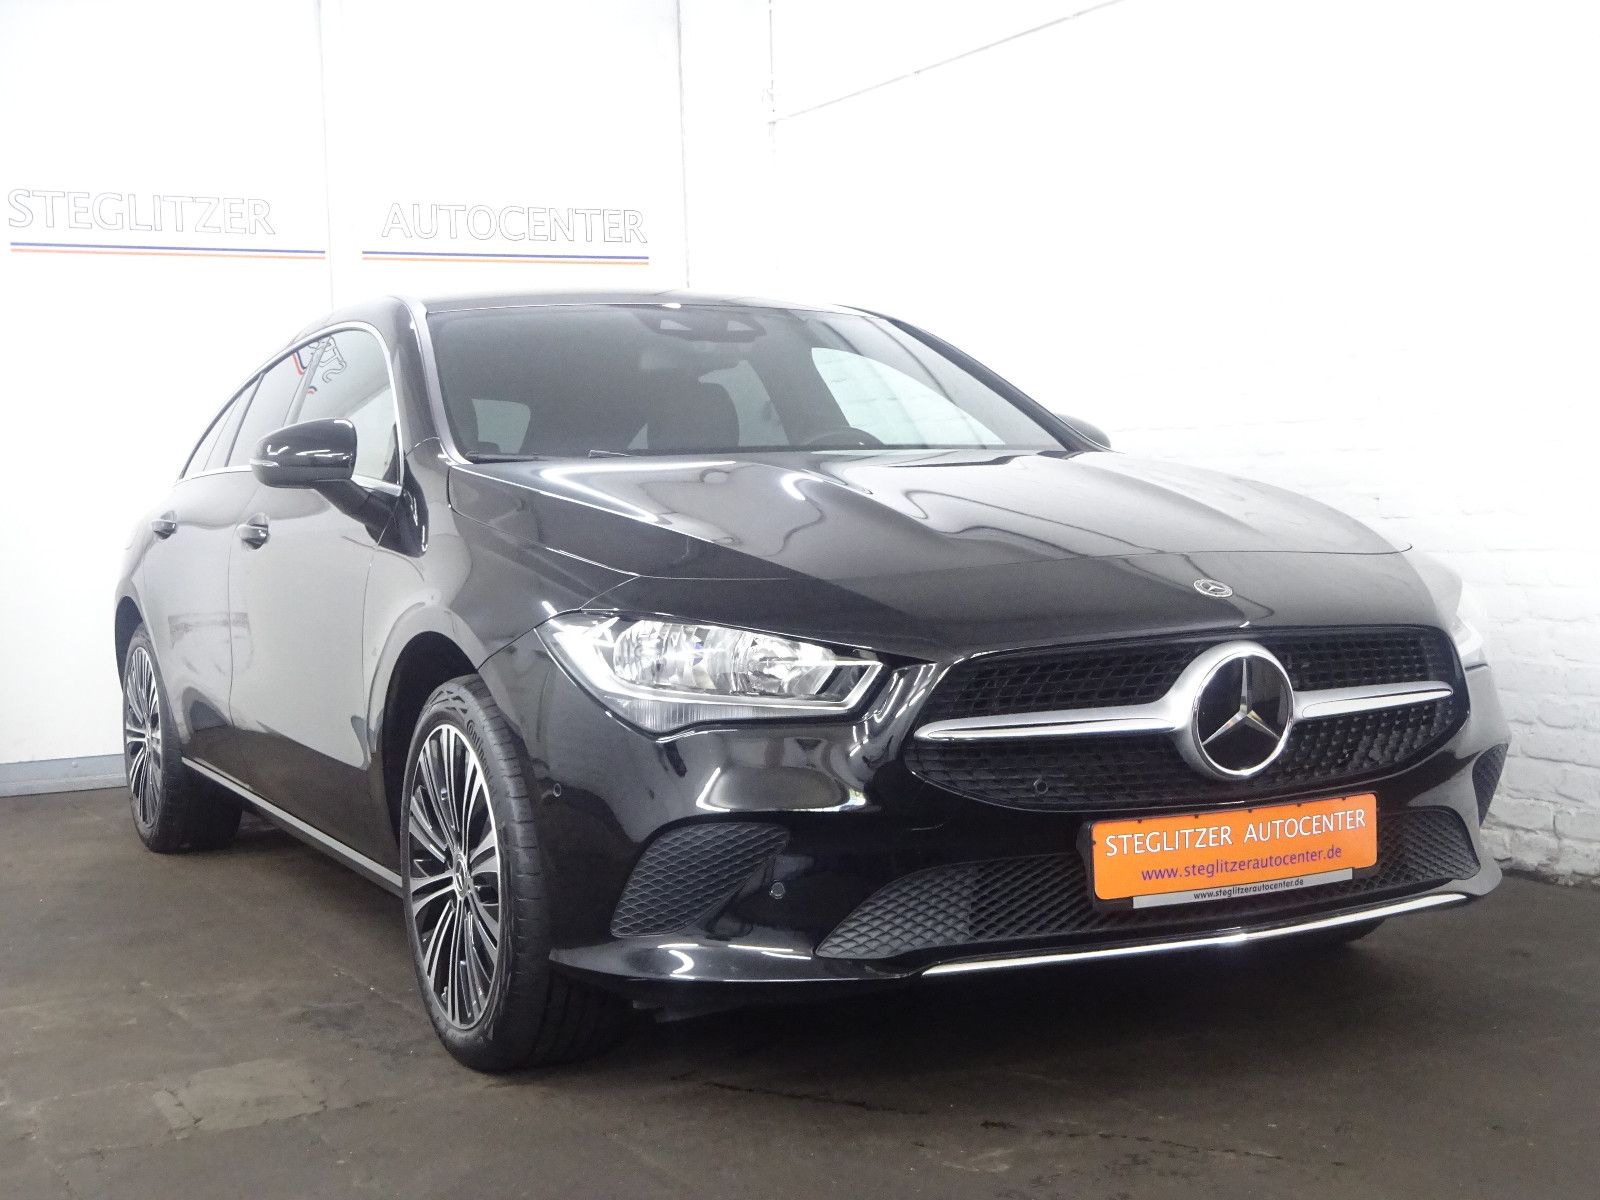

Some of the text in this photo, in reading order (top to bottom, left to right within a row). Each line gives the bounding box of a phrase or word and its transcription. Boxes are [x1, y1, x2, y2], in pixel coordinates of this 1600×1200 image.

[8, 188, 648, 243] STEGLITZER AUTOCENTER
[1105, 809, 1366, 857] STEGLITZER AUTOCENTER
[1141, 844, 1342, 881] www.steglitzerautocenter.de
[1193, 878, 1304, 899] www.steglitzerautocenter.de
